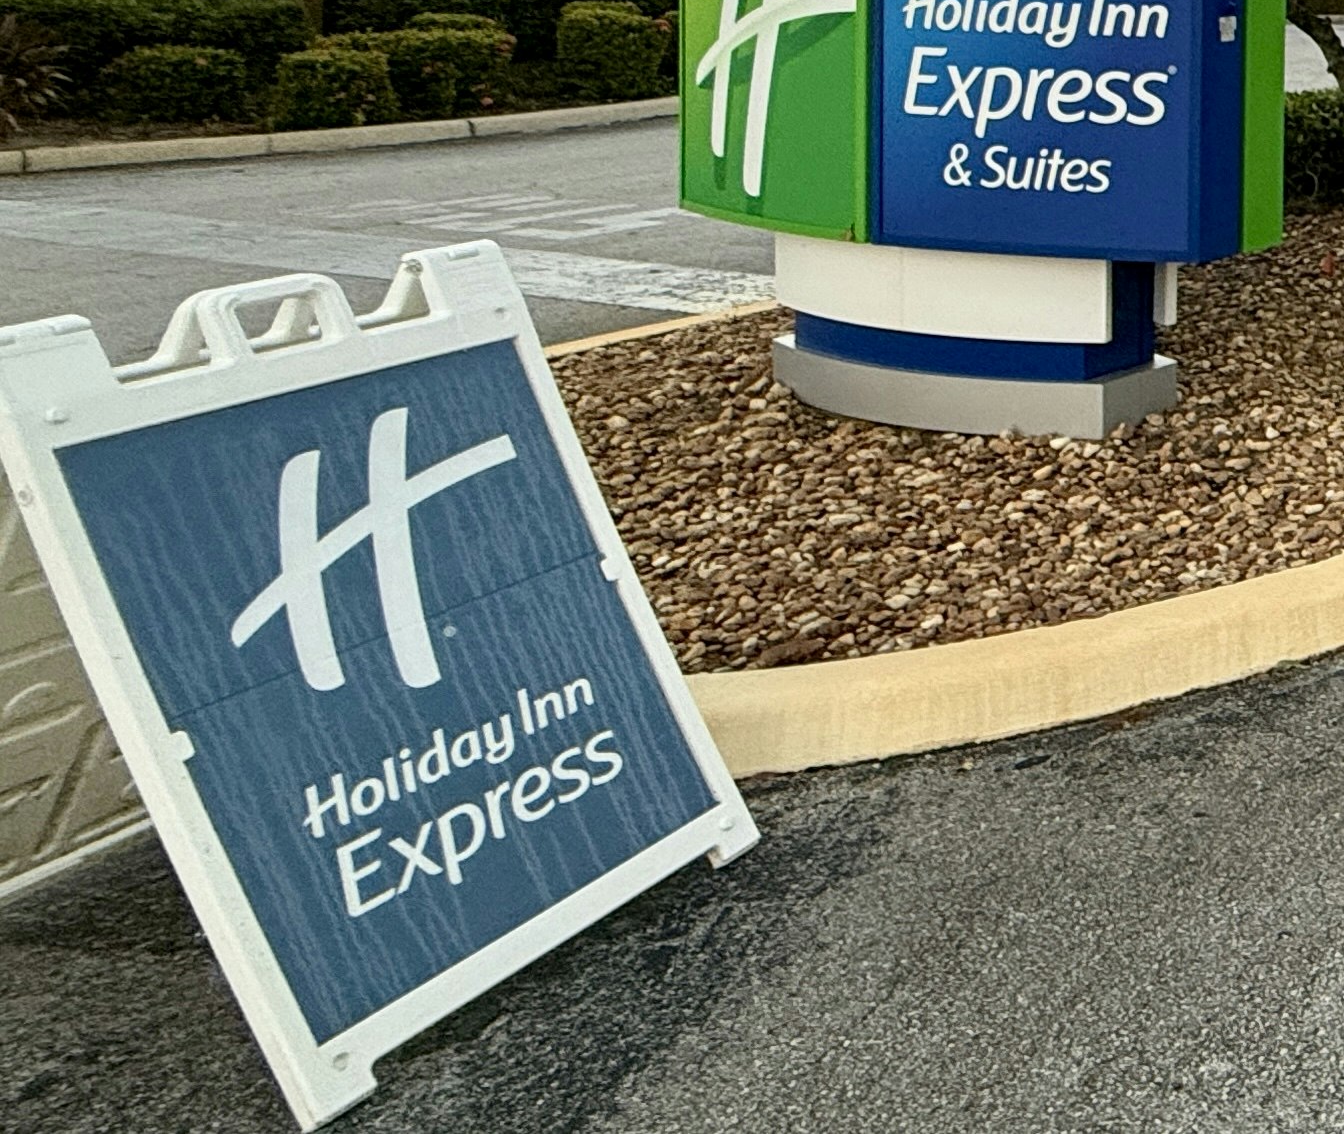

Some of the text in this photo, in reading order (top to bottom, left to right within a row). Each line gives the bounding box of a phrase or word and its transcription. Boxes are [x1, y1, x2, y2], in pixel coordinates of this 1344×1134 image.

[902, 46, 1169, 139] Express
[942, 142, 1112, 193] & Suites
[302, 677, 595, 839] Holiday Inn
[335, 729, 624, 918] Express
